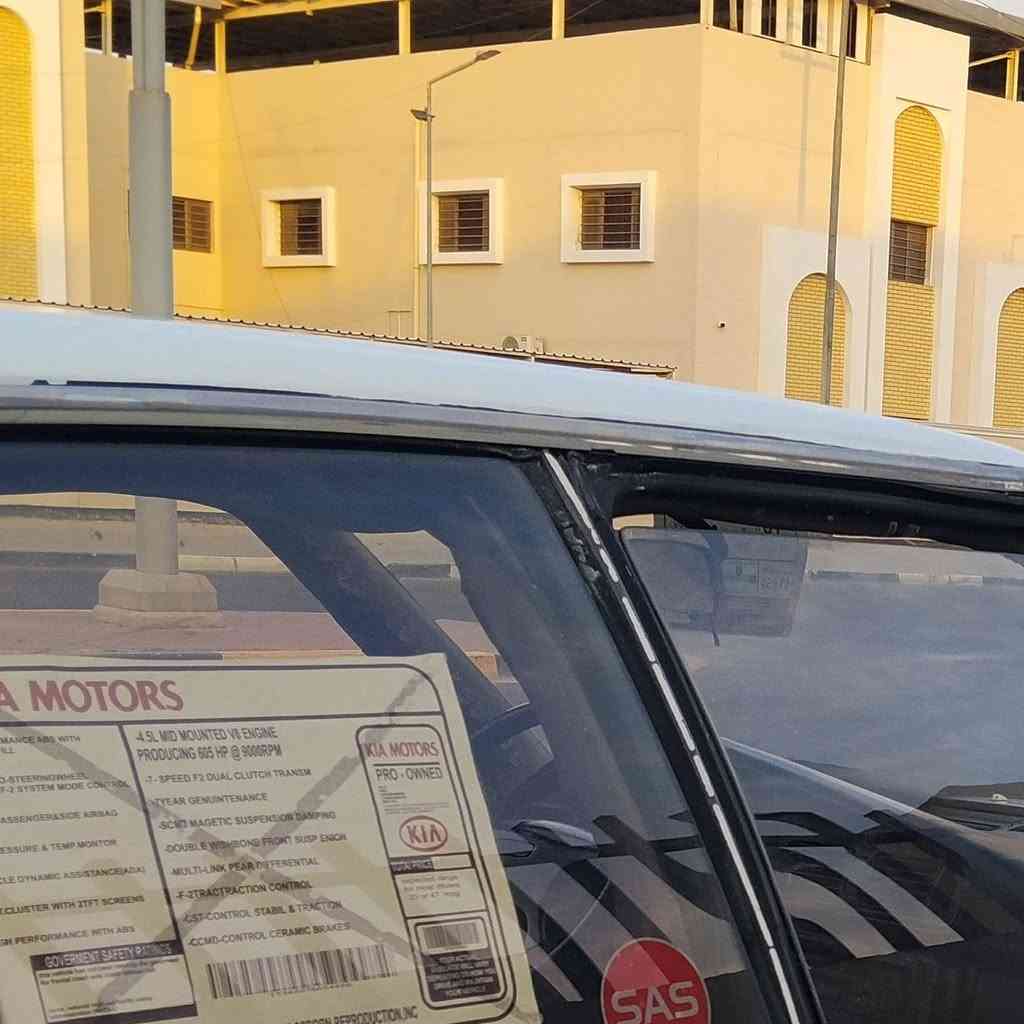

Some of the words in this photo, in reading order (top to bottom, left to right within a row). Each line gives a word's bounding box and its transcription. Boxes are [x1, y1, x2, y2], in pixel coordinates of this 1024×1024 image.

[28, 679, 184, 713] MOTORS
[159, 728, 178, 743] MID
[179, 728, 227, 742] MOUNTED
[240, 726, 279, 740] ENGINE
[136, 747, 197, 762] PRODUCING
[215, 745, 229, 760] HP
[367, 743, 389, 758] KIA
[390, 741, 439, 757] MOTORS
[206, 772, 232, 782] DUAL
[234, 770, 272, 781] CLUTCH
[405, 766, 442, 780] OWNED
[57, 782, 84, 791] MODE
[234, 812, 294, 826] SUSPENSION
[407, 824, 442, 843] KIA
[261, 835, 293, 847] FRONT
[268, 880, 313, 892] CONTROL
[50, 901, 77, 910] WITH
[287, 905, 296, 914] &
[296, 900, 344, 913] TRACTION
[15, 933, 88, 945] PERFORMANCE
[270, 926, 313, 939] CERAMIC
